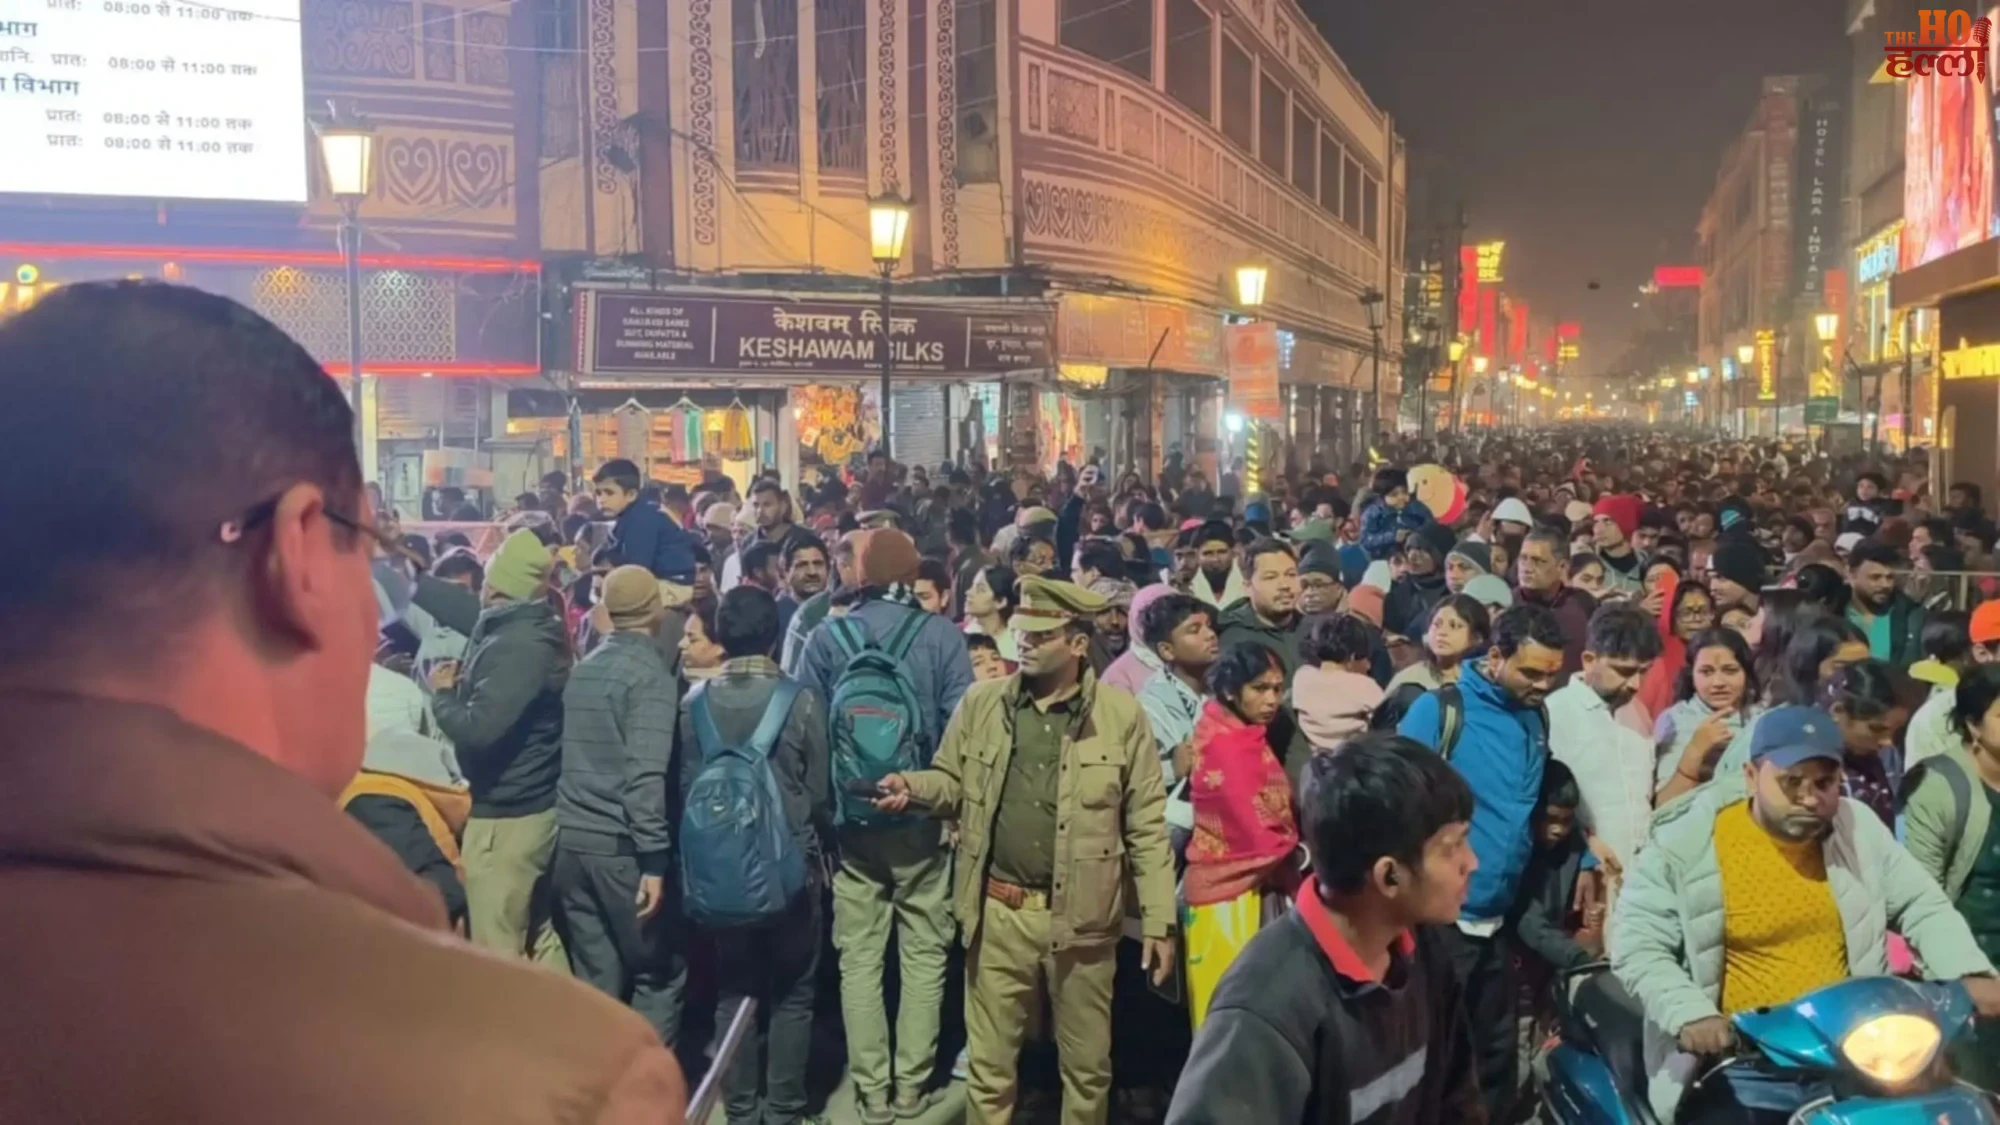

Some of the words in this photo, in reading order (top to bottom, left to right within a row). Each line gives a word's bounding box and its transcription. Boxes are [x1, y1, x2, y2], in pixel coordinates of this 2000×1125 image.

[103, 1, 151, 15] 08:00
[156, 1, 171, 17] से
[176, 6, 220, 20] 11:00
[226, 11, 253, 22] तक
[107, 56, 155, 71] 08:00
[161, 57, 176, 73] से
[181, 61, 225, 75] 11:00
[231, 64, 257, 76] तक
[14, 73, 80, 96] विभाग
[103, 112, 150, 126] 08:00
[155, 110, 170, 127] से
[176, 116, 220, 130] 11:00
[225, 118, 252, 131] तक
[104, 136, 151, 150] 08:00
[156, 135, 171, 152] से
[177, 140, 221, 154] 11:00
[226, 141, 254, 154] तक
[1815, 119, 1828, 167] HOTEL
[1808, 226, 1821, 273] INDIA
[630, 306, 645, 315] ALL
[646, 307, 671, 316] KINDS
[672, 307, 684, 316] OF
[773, 306, 853, 337] केशवम्
[645, 328, 680, 338] DUPATTA
[634, 351, 676, 360] AVAILABLE
[655, 340, 695, 350] MATERIAL
[739, 337, 875, 360] KESHAWAM
